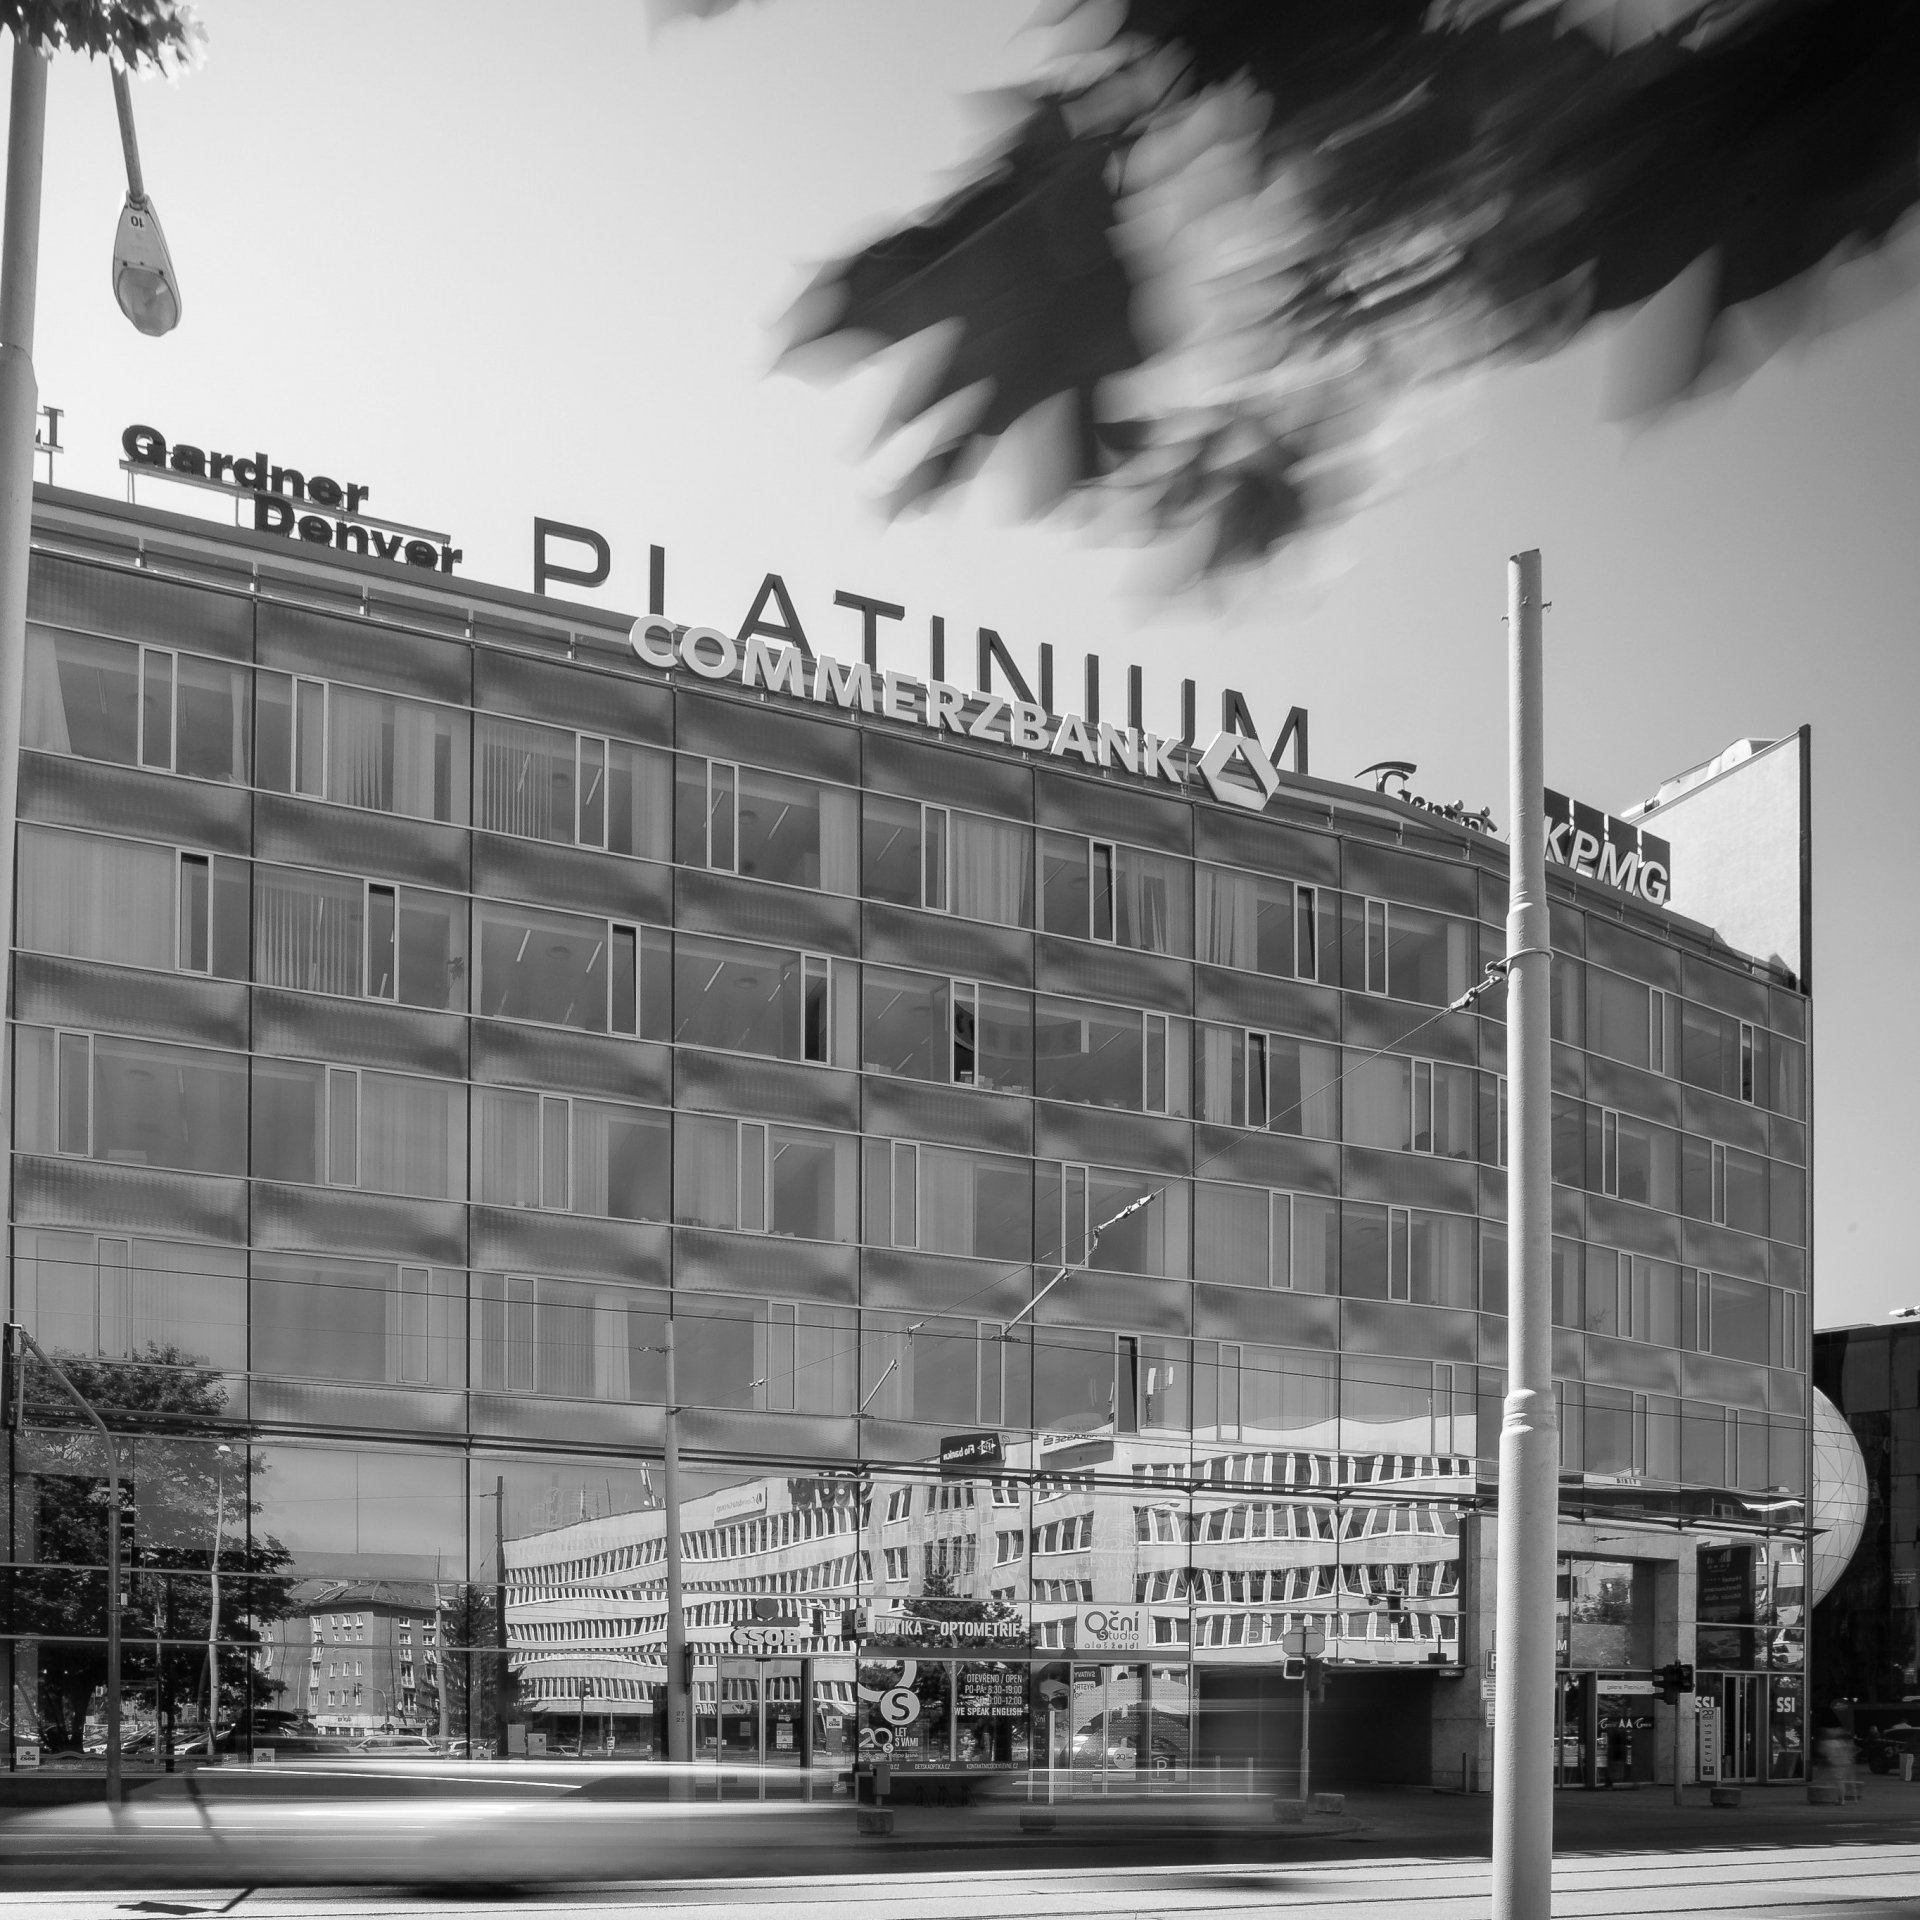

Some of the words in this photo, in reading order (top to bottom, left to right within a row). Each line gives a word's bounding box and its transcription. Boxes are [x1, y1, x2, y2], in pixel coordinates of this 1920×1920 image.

[121, 424, 369, 512] Gardner
[254, 493, 463, 574] Denver
[629, 613, 1189, 785] COMMERZBANK
[1544, 814, 1669, 906] KPMG
[875, 1620, 923, 1636] OPTIKA
[940, 1621, 1020, 1638] OPTOMETRIE
[1084, 1610, 1140, 1634] Oční
[966, 1673, 1000, 1683] OTEVŘENO
[1005, 1674, 1023, 1683] OPEN
[954, 1707, 966, 1716] WE
[967, 1707, 990, 1716] SPEAK
[992, 1707, 1022, 1716] ENGLISH
[1776, 1696, 1796, 1713] SSI
[858, 1727, 893, 1749] 20
[894, 1727, 907, 1737] LET
[901, 1736, 919, 1747] VÁMI
[1704, 1723, 1713, 1763] CYRRUS
